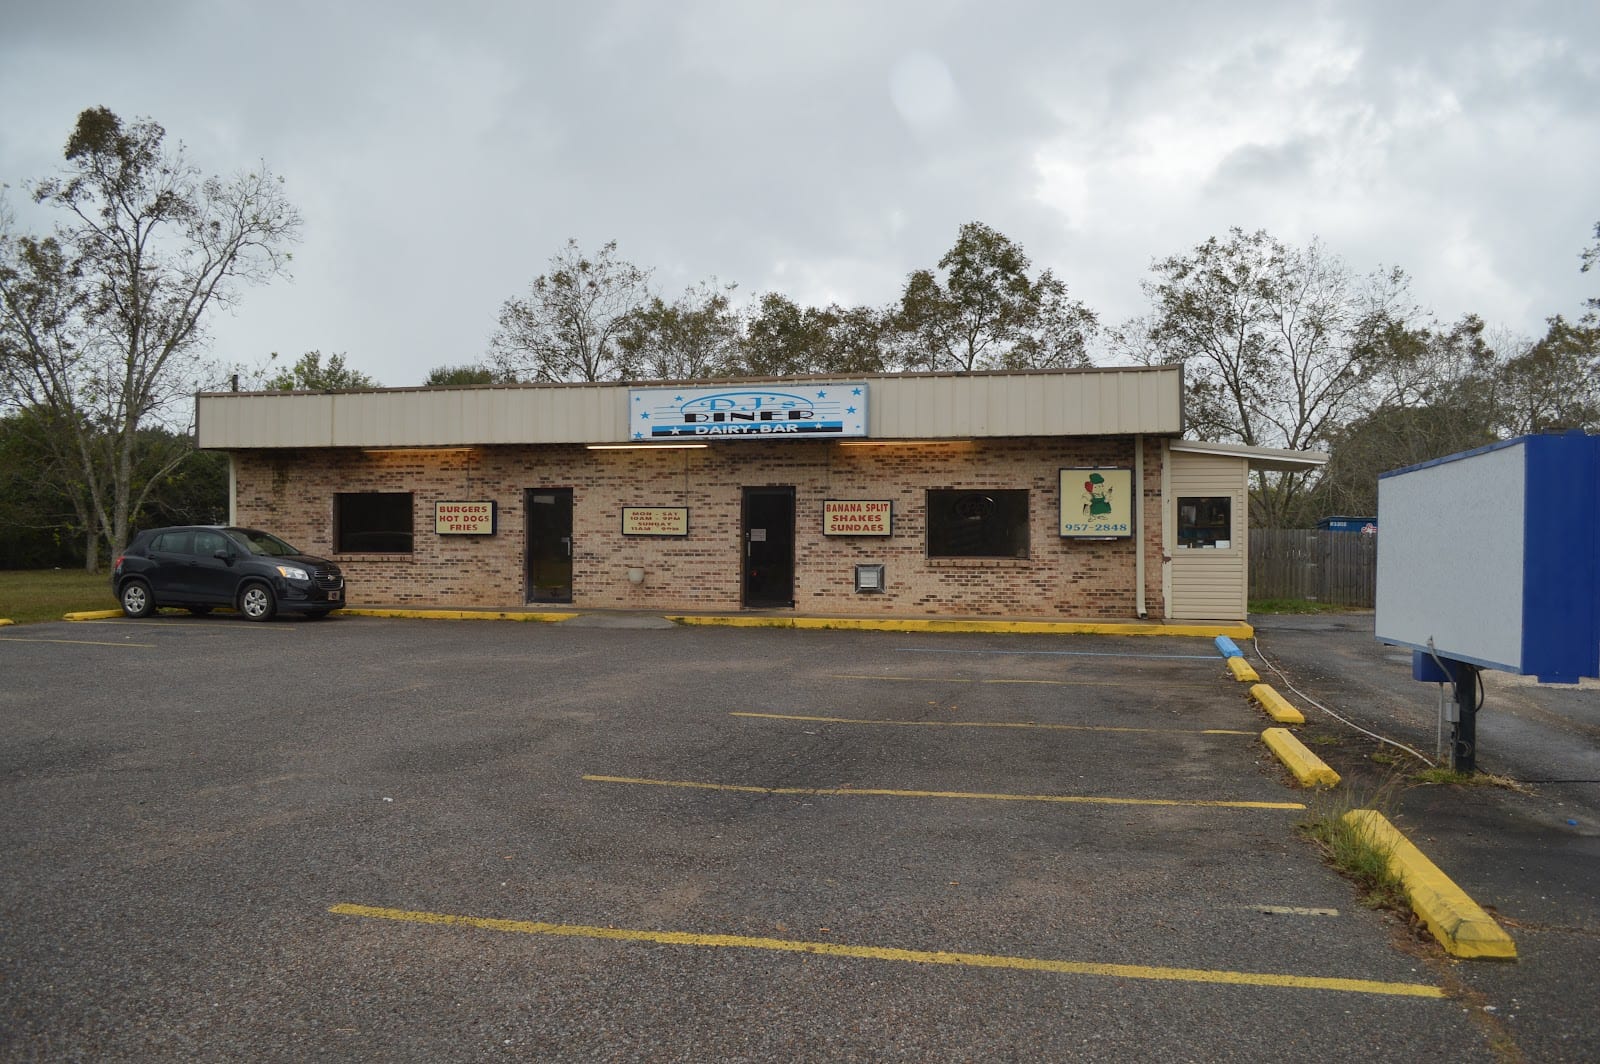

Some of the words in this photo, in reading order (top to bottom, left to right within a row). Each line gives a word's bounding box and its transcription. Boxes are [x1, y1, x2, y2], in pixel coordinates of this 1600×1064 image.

[684, 410, 814, 423] DINER
[760, 423, 799, 433] BAR
[826, 503, 862, 512] BANANA
[865, 503, 889, 512] SPLIT
[832, 514, 882, 522] SHAKES
[830, 524, 884, 532] SUNDAES
[1065, 523, 1128, 532] 957-2848
